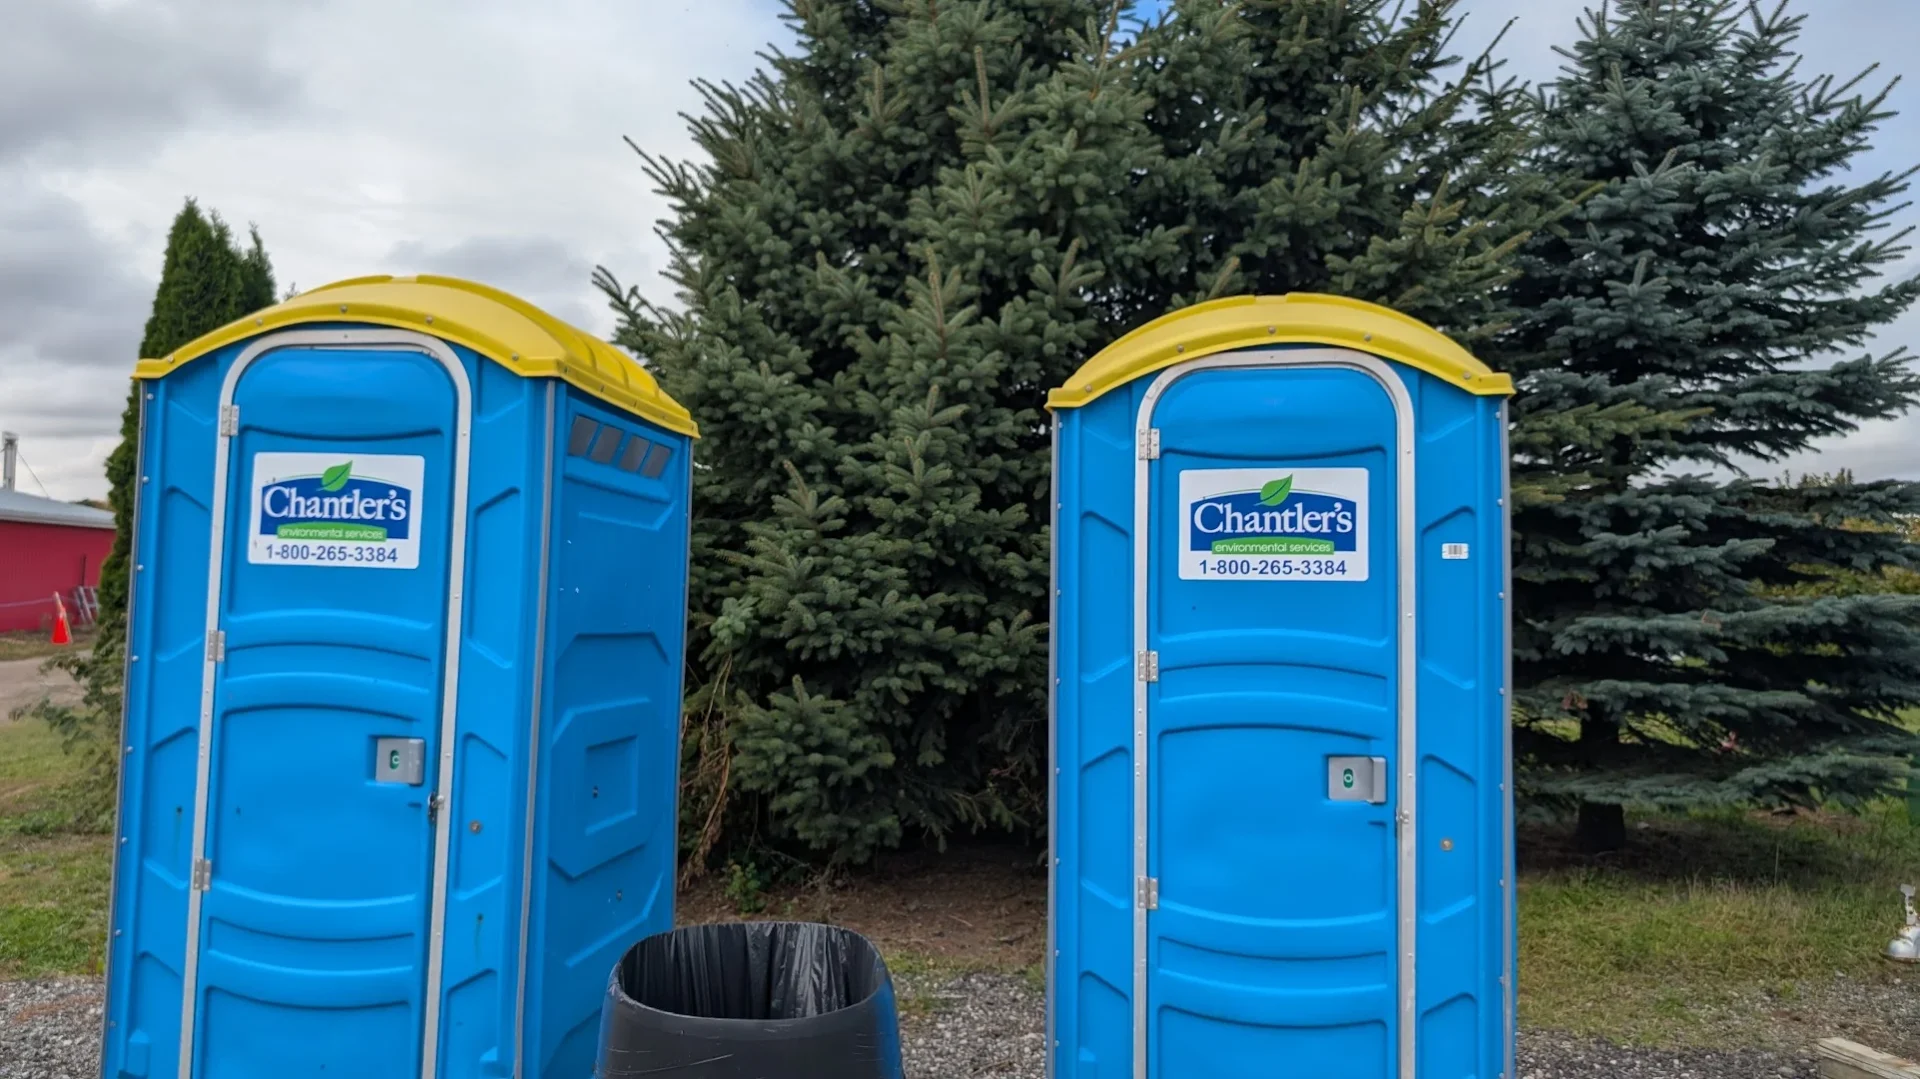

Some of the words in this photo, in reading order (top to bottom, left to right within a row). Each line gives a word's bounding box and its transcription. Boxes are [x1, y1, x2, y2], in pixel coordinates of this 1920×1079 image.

[264, 486, 406, 520] Chantler's
[1194, 502, 1353, 533] Chantler's
[280, 528, 343, 538] environmental
[345, 530, 383, 539] services
[266, 544, 398, 563] 1-800-265-3384
[1215, 542, 1287, 552] environmental
[1289, 543, 1331, 552] services
[1199, 560, 1347, 575] 1-800-265-3384
